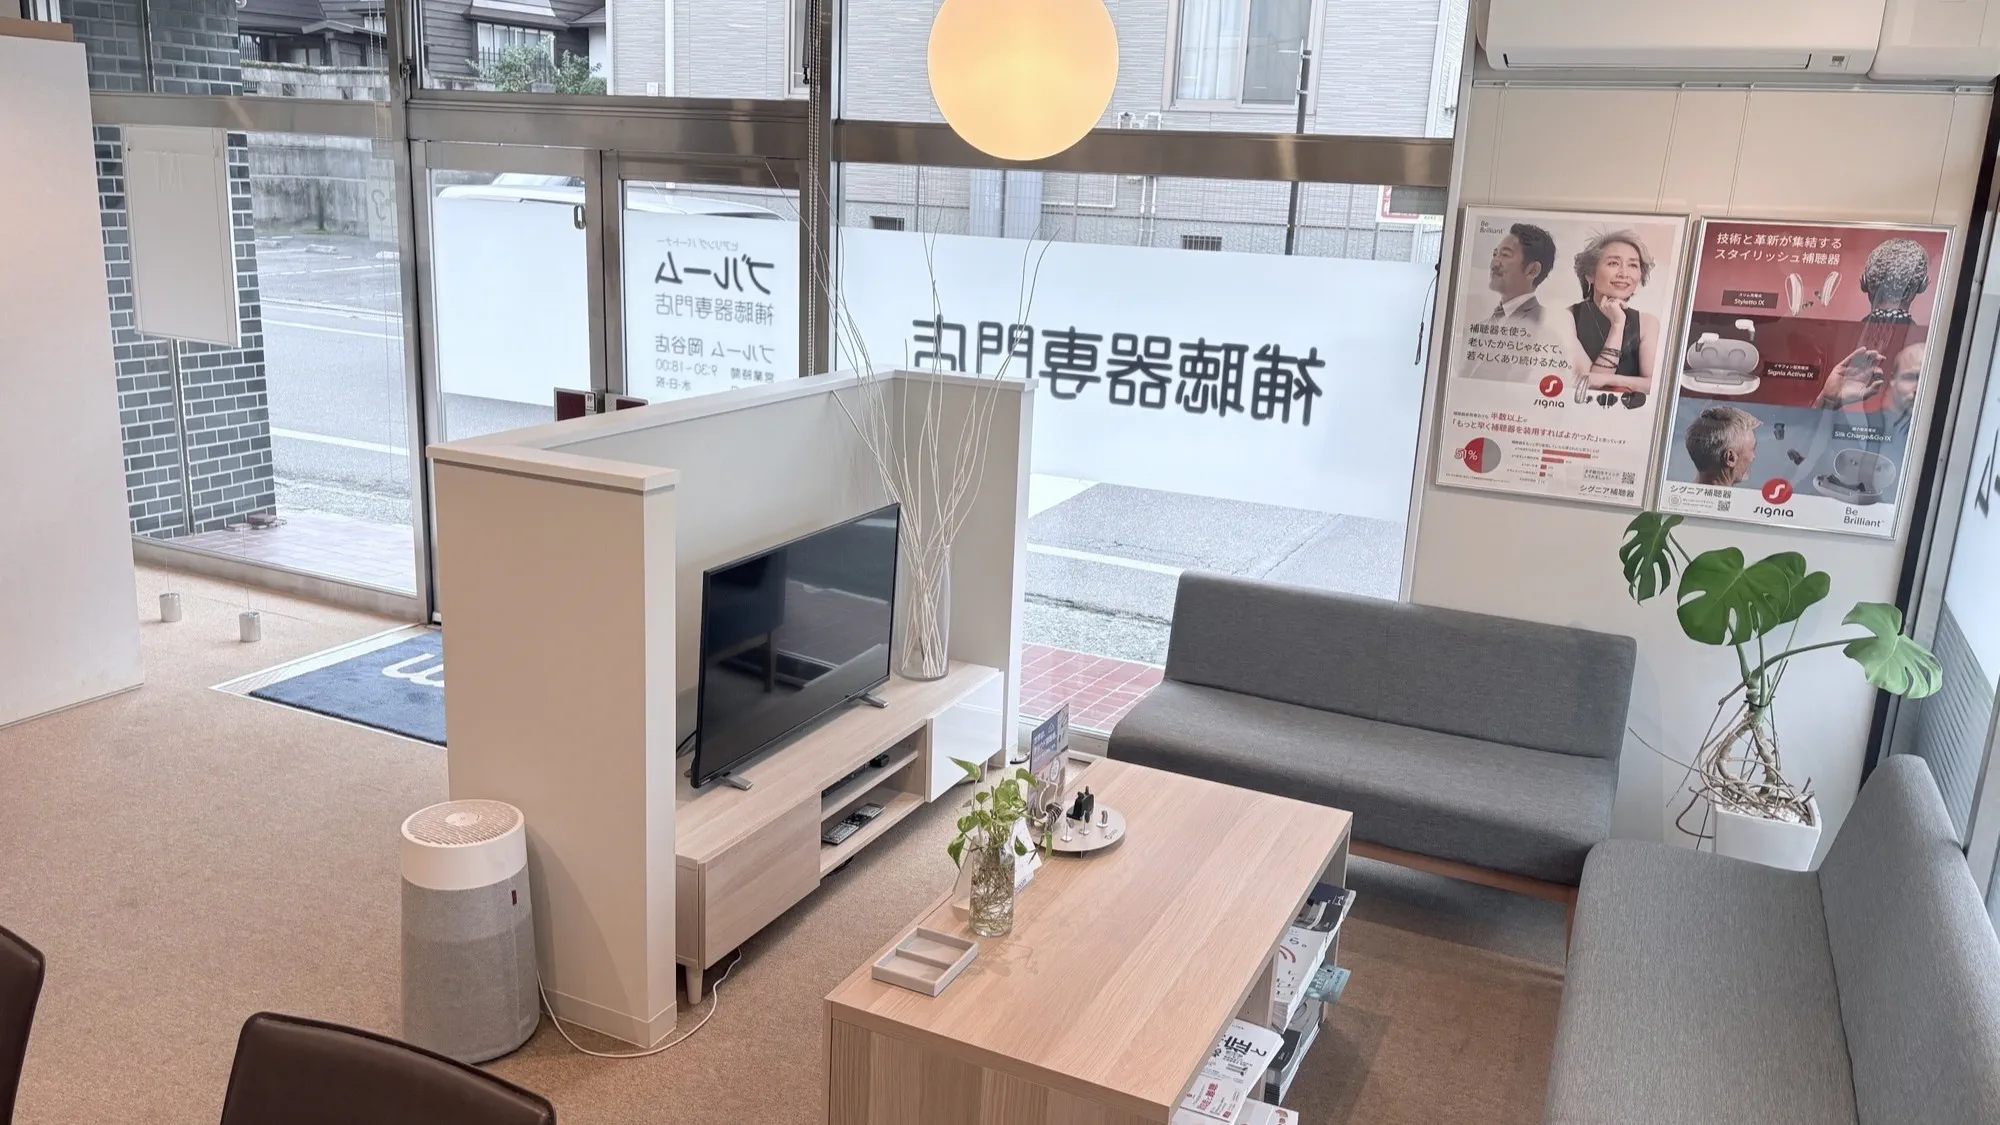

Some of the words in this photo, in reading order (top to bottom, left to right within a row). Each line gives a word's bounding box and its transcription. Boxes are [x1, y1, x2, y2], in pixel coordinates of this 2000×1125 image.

[1716, 232, 1842, 249] 技術と革新が集結する
[1715, 249, 1840, 265] スタイリッシュ補聴器
[1734, 298, 1757, 306] Styletto
[1470, 323, 1531, 338] 補聴器を使う。
[1468, 337, 1562, 354] 老いたからじゃなくて、
[1467, 351, 1572, 370] 若々しくあり続けるため。
[1533, 399, 1565, 409] signia
[1846, 432, 1883, 440] Charge&Go
[1454, 448, 1478, 460] 51%
[1580, 485, 1635, 498] シグニア補聴器
[1670, 485, 1732, 499] シグニア補聴器
[1753, 506, 1794, 518] signia
[1845, 507, 1858, 516] Be
[1843, 516, 1881, 528] Brilliant
